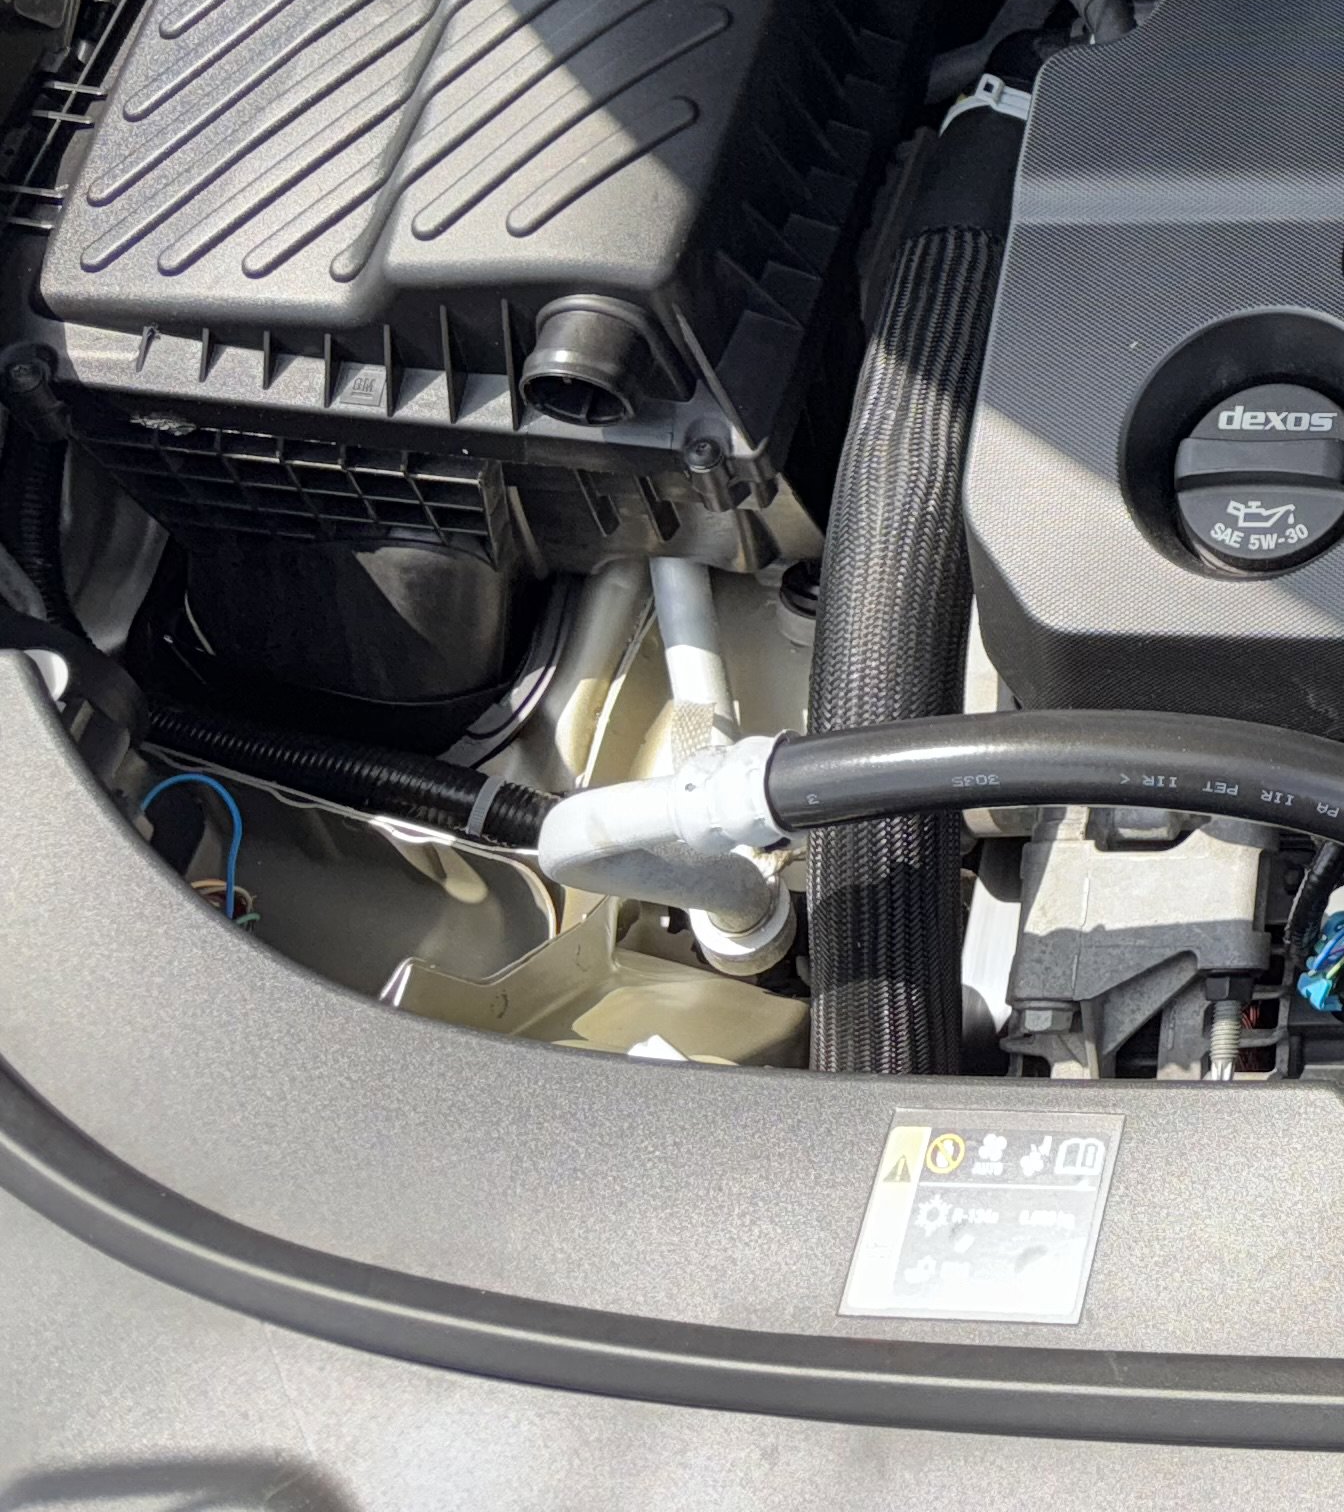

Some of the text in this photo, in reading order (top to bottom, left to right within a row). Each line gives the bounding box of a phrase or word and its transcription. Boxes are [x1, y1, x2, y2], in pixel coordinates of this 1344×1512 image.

[352, 377, 377, 393] GM
[1217, 405, 1338, 432] dexos
[1210, 523, 1309, 550] SAE 5W-30
[950, 772, 1001, 789] 3035
[1141, 773, 1178, 789] IIR
[1201, 779, 1240, 797] PET
[1259, 787, 1295, 808] IIR
[1315, 800, 1341, 820] PA
